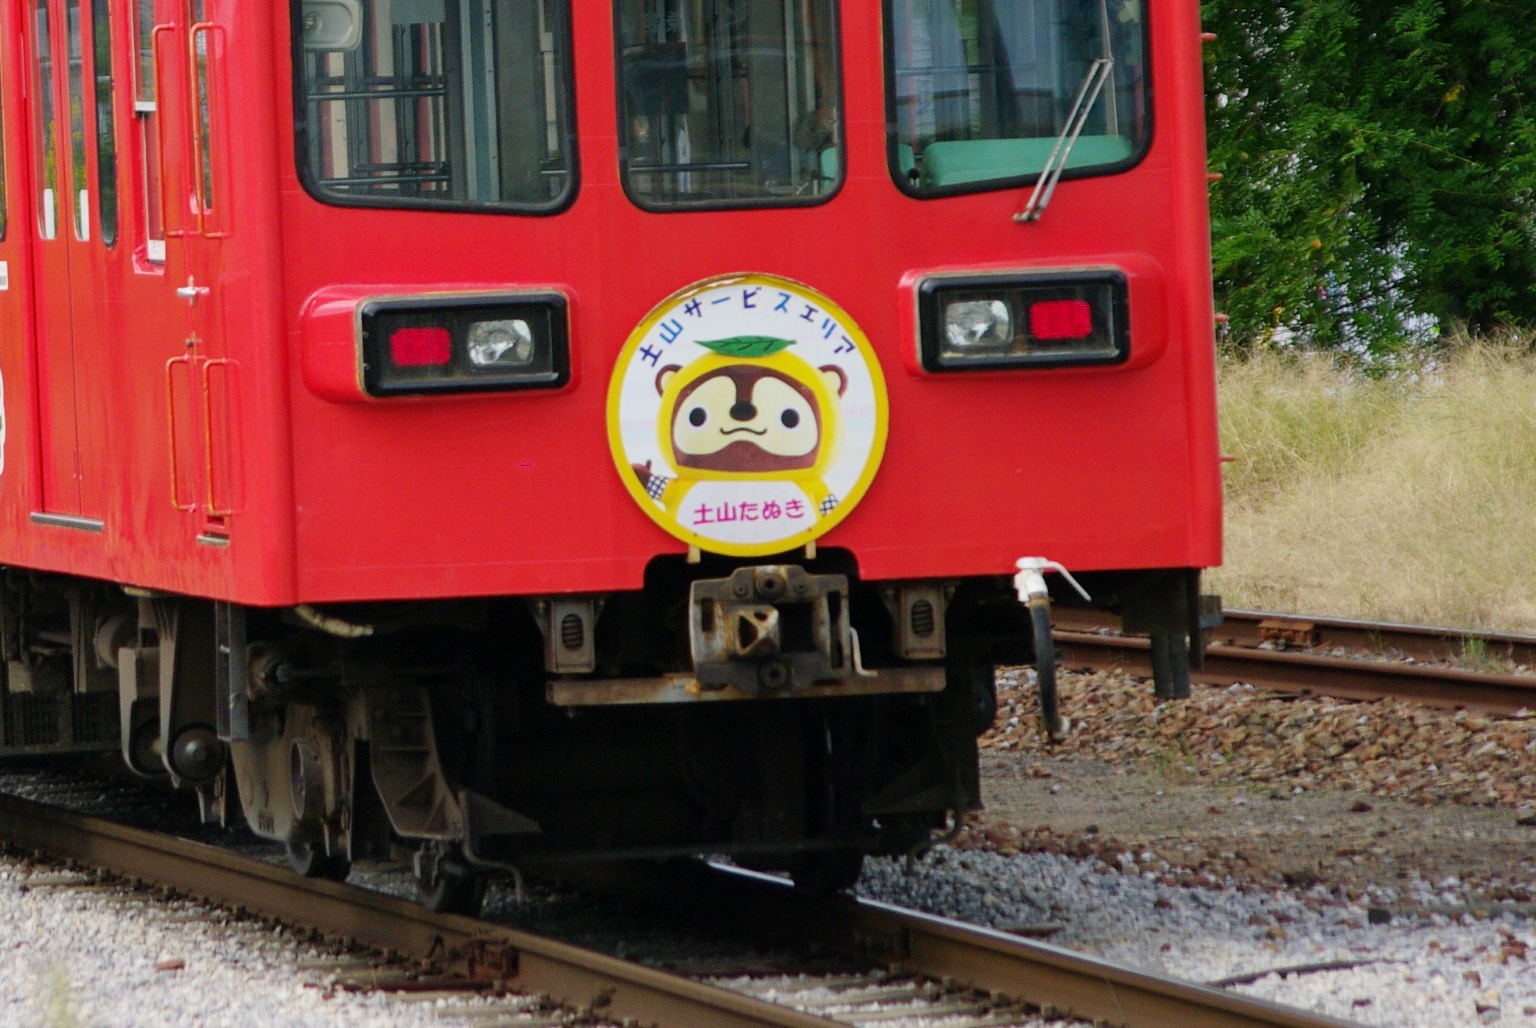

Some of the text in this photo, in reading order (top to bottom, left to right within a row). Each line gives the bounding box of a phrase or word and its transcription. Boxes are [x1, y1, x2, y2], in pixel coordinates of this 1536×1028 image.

[638, 286, 856, 367] 土山サービスエリア
[693, 498, 805, 526] 土山たぬき
